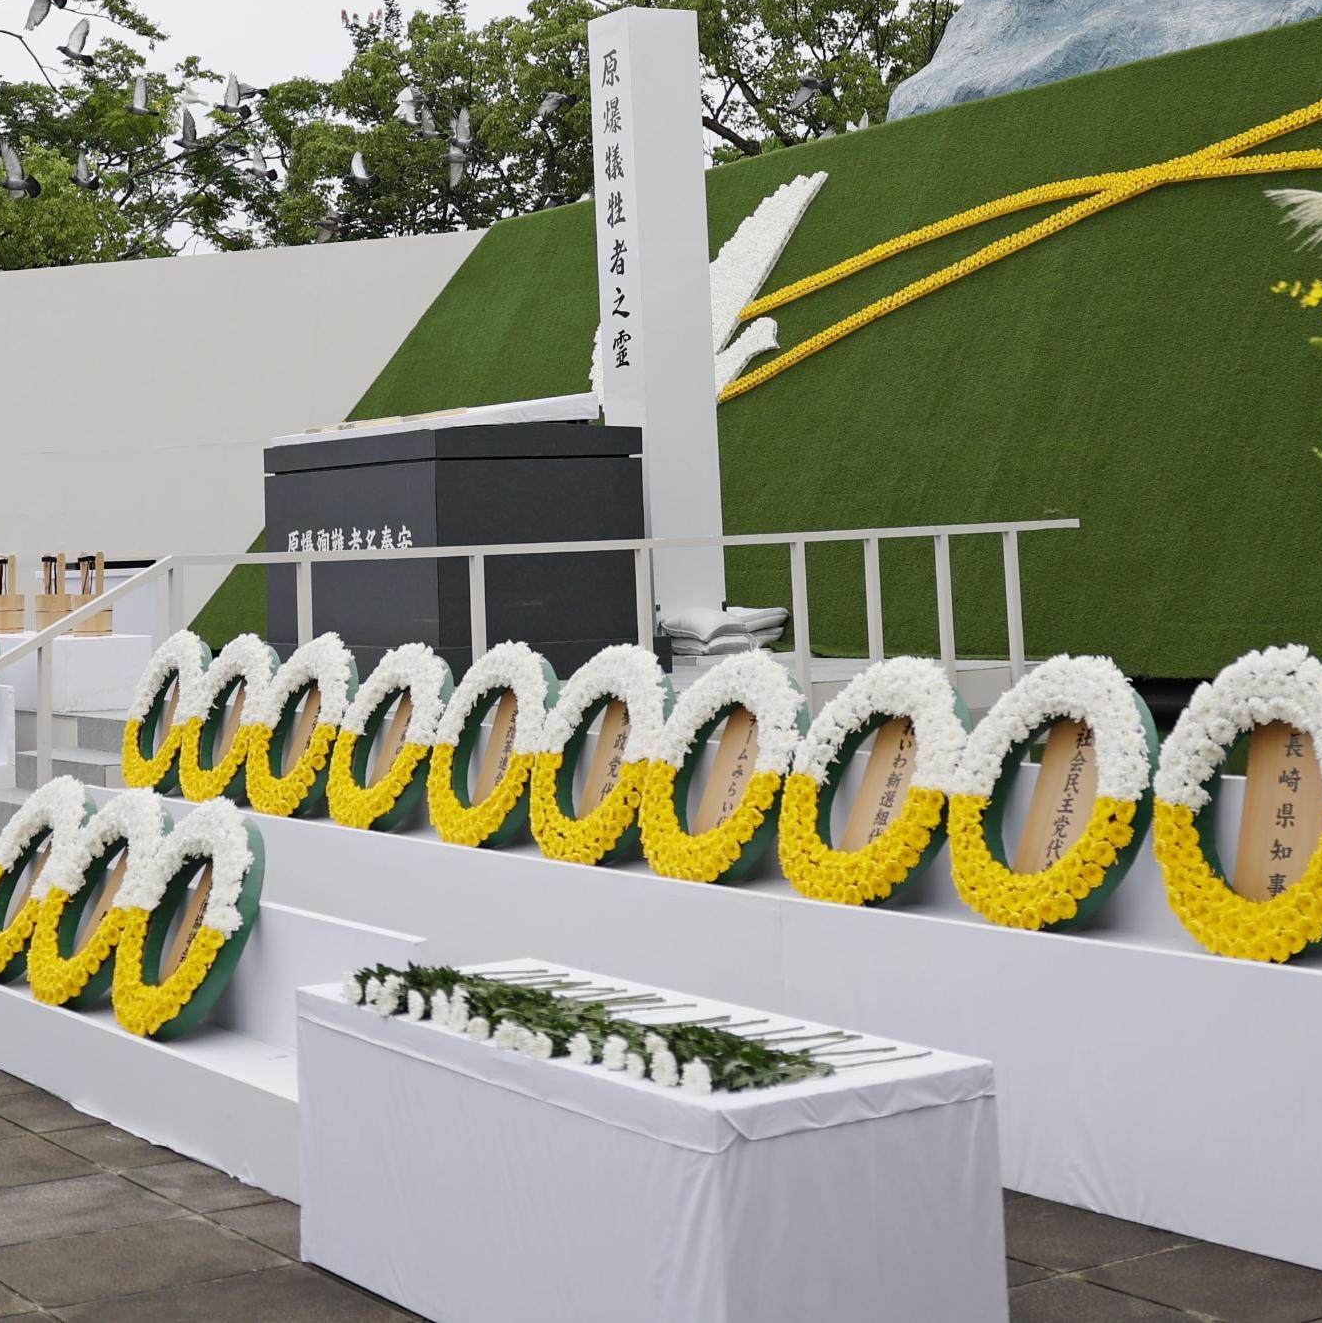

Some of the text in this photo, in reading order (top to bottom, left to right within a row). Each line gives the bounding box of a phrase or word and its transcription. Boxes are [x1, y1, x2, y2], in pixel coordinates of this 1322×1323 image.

[601, 48, 632, 369] 原爆犠牲者之霊
[1041, 728, 1094, 872] 社会民主党代
[1266, 732, 1305, 898] 長崎県知事
